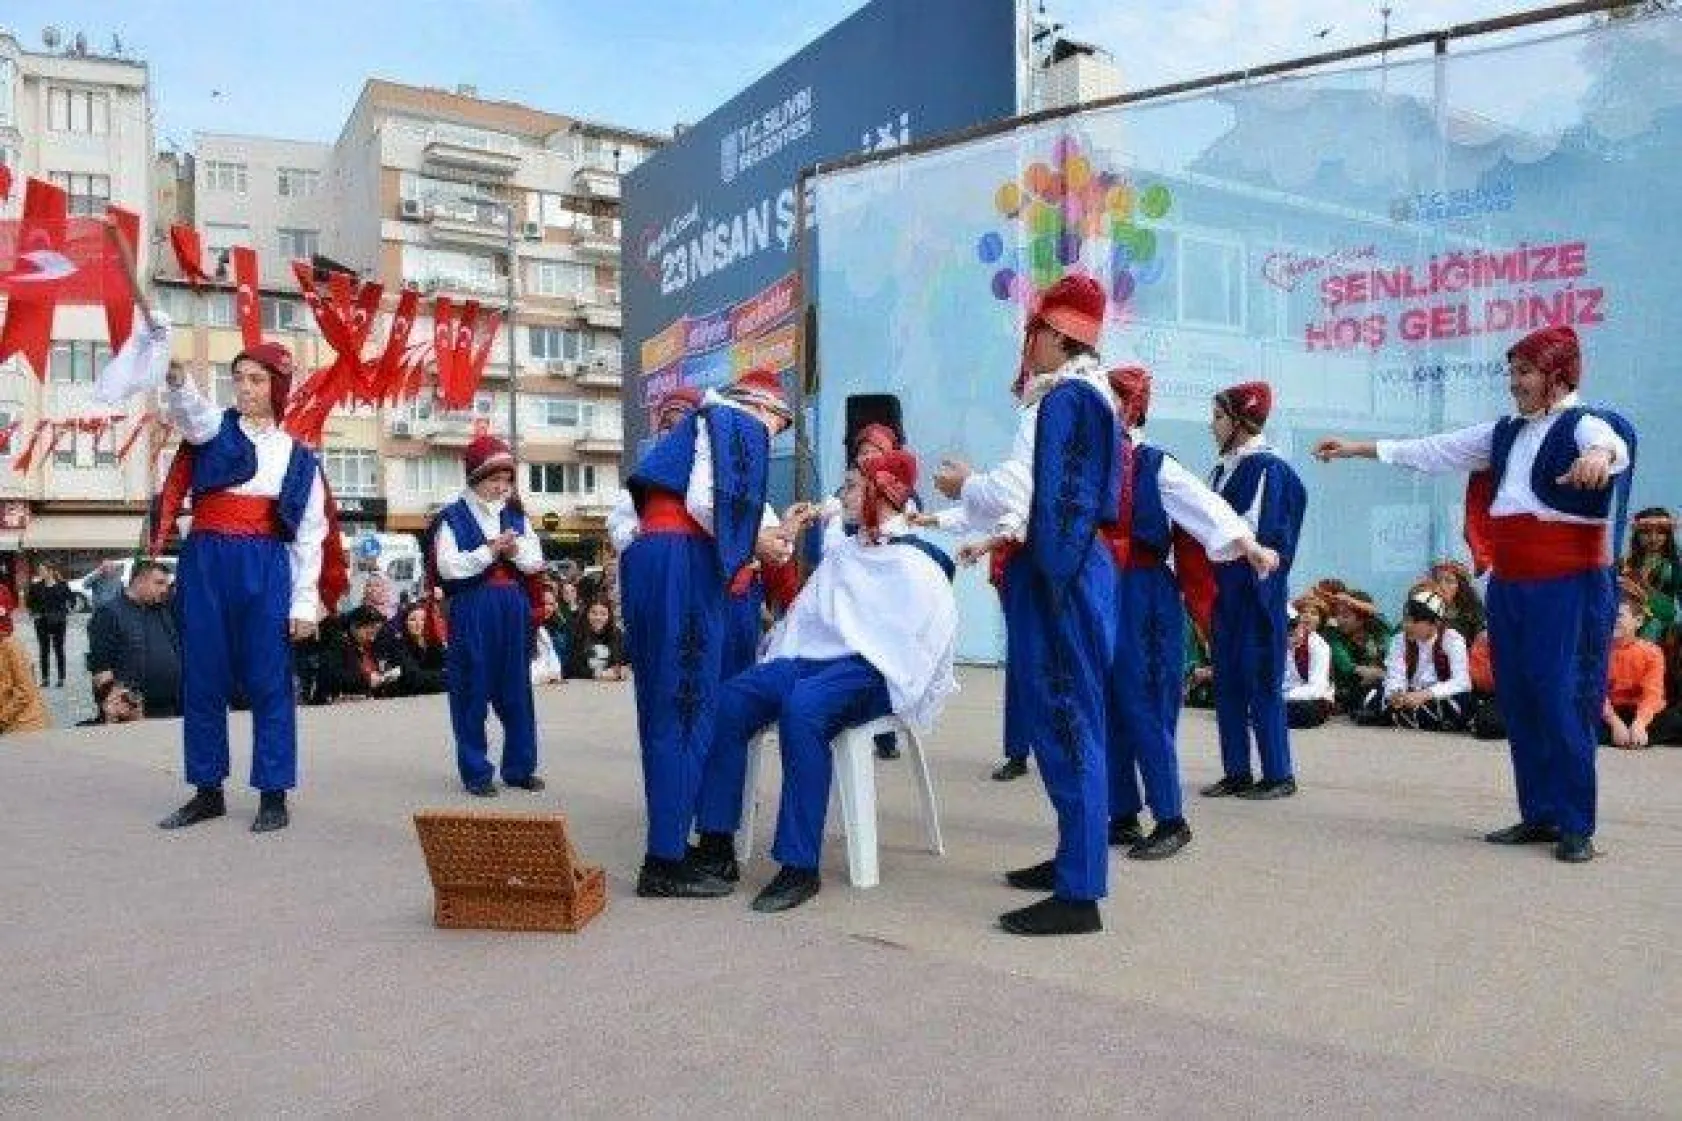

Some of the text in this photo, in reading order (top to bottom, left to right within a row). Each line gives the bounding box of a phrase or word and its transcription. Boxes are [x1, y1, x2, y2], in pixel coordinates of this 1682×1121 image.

[660, 244, 689, 296] 23
[1304, 282, 1604, 354] HOŞ GELDİNİZ
